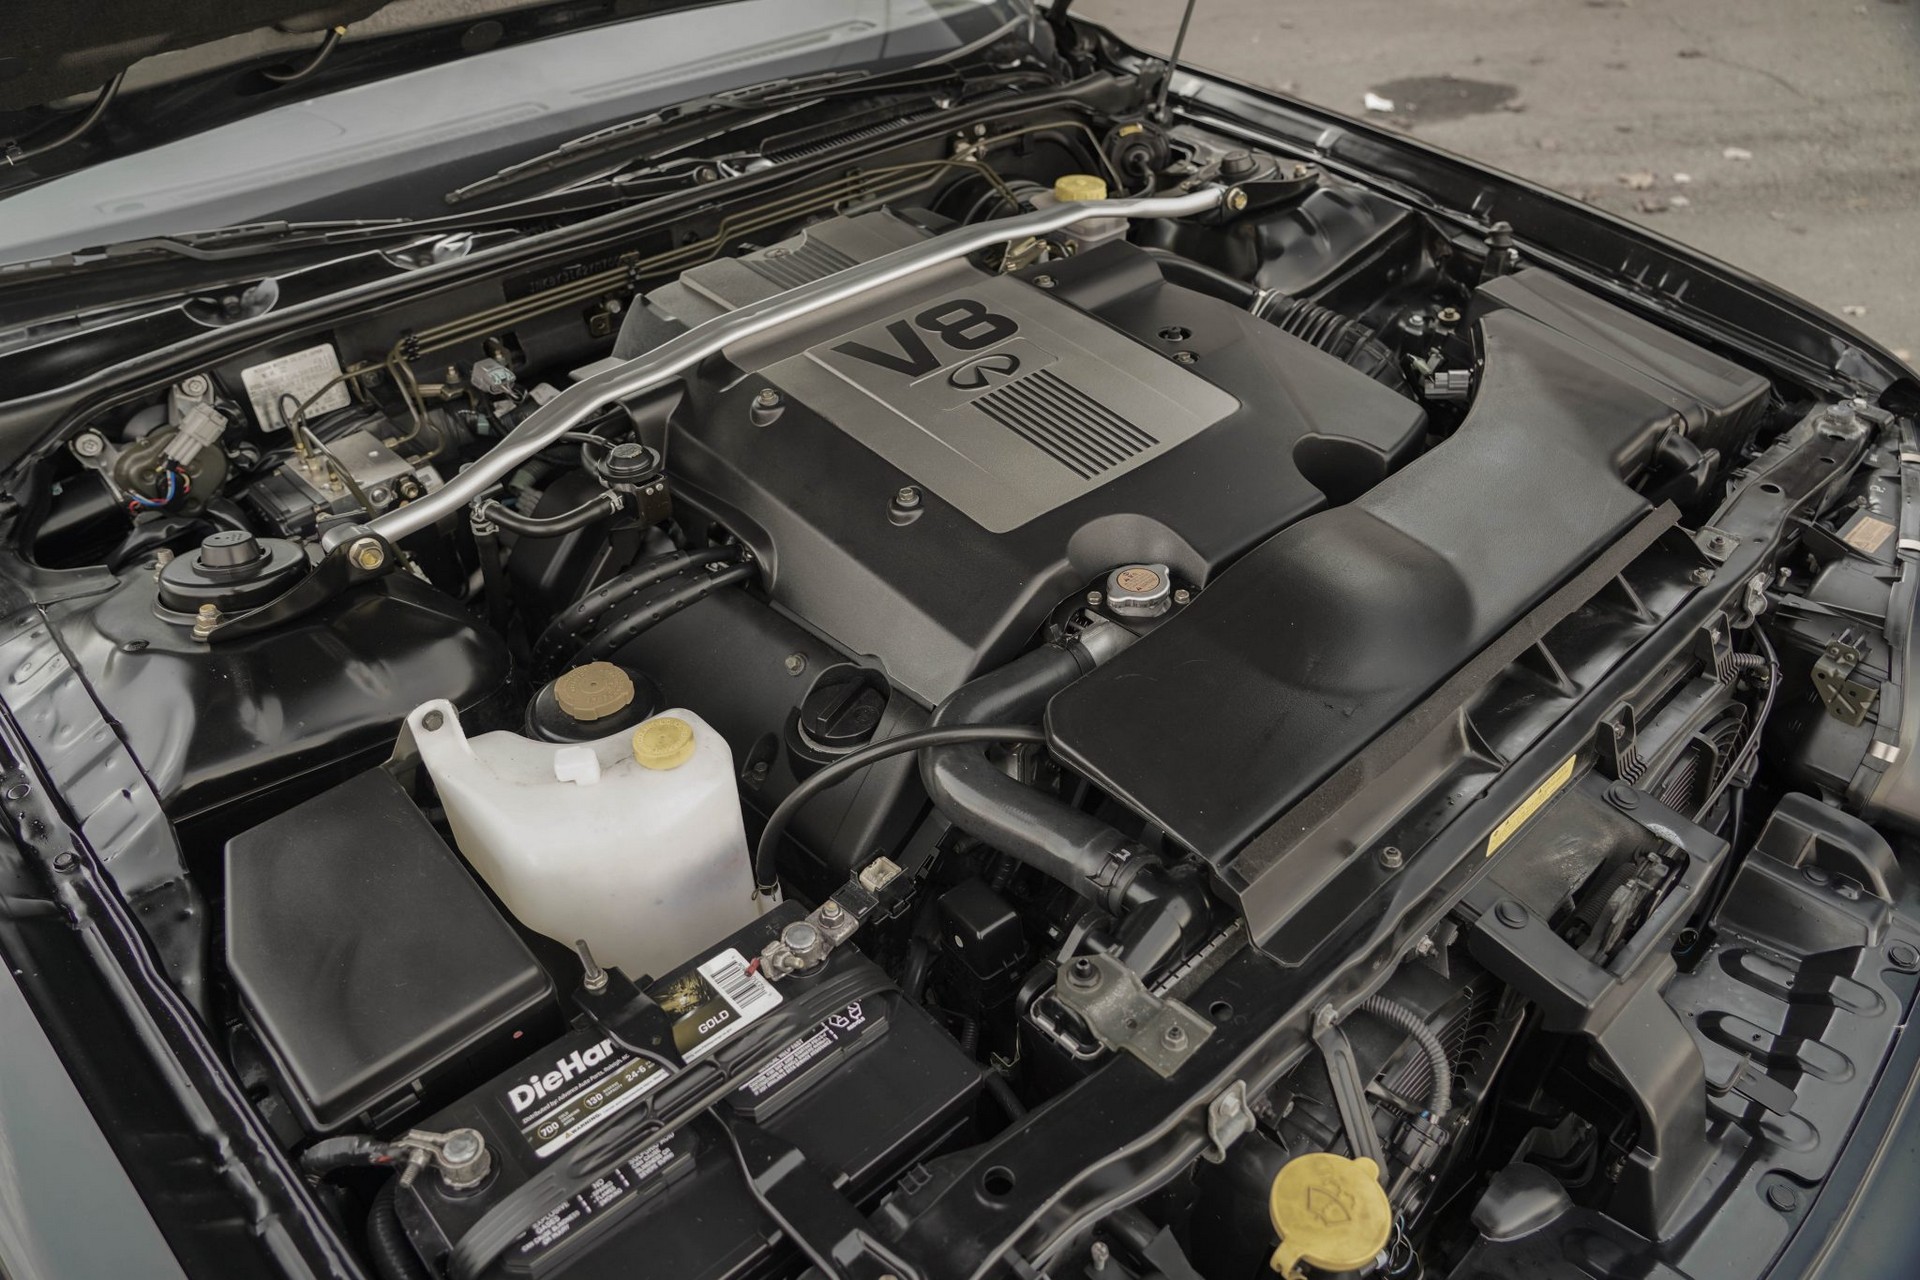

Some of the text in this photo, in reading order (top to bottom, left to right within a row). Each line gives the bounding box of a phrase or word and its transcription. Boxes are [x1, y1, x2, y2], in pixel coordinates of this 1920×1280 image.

[830, 299, 1018, 377] V8
[698, 1009, 730, 1034] GOLD
[507, 1038, 615, 1113] DieHar
[557, 1086, 579, 1102] Advance
[578, 1078, 591, 1089] Auto
[586, 1092, 604, 1107] 130
[540, 1121, 560, 1137] 700
[592, 1178, 605, 1189] NO
